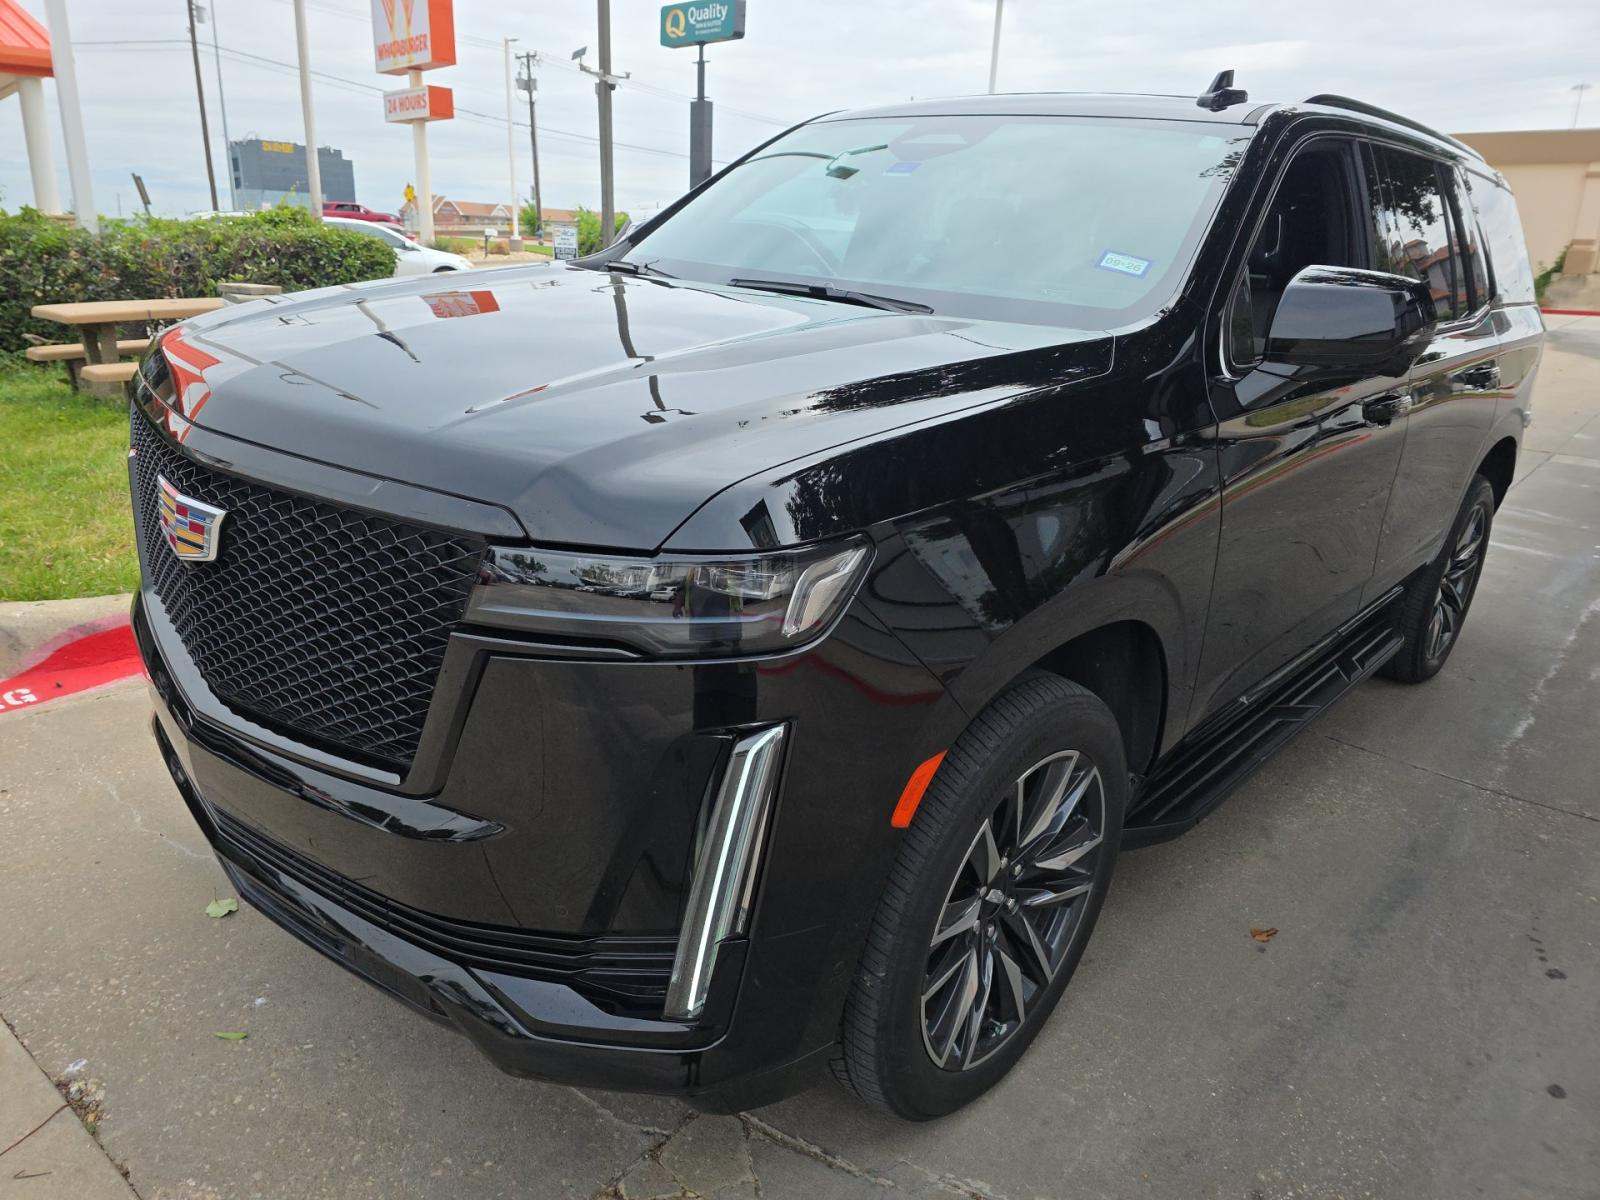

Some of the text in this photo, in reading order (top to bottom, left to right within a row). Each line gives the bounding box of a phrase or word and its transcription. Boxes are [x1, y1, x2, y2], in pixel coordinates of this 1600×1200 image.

[688, 3, 728, 25] Quality
[388, 93, 428, 114] 24 HOURS
[1104, 256, 1142, 272] 09-26
